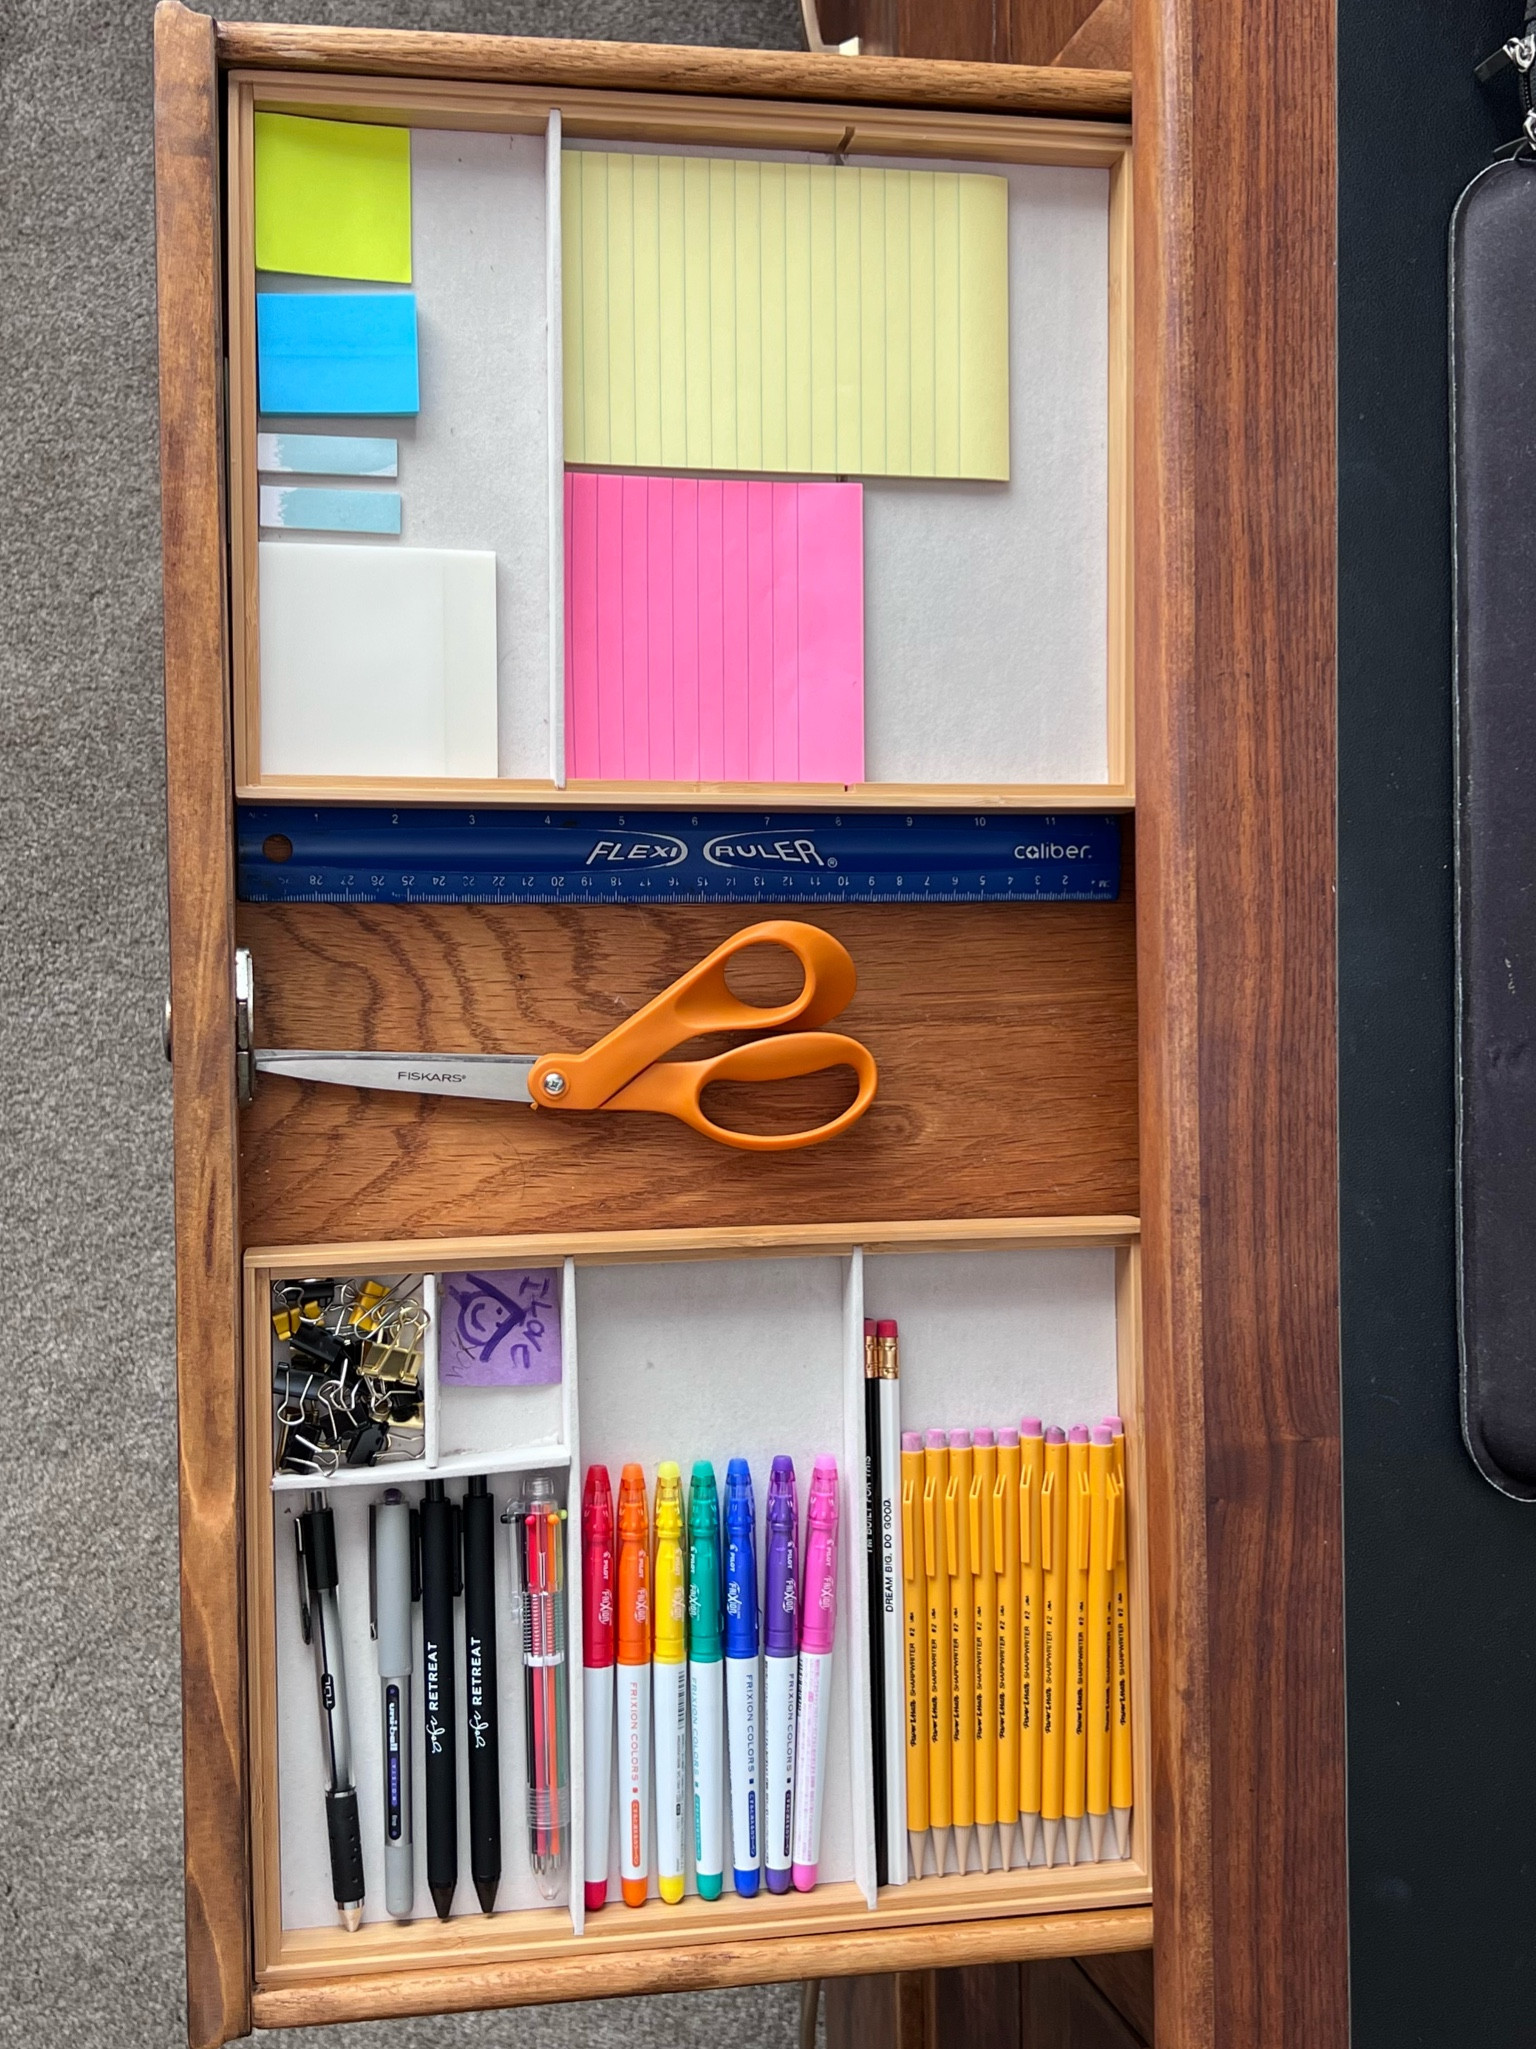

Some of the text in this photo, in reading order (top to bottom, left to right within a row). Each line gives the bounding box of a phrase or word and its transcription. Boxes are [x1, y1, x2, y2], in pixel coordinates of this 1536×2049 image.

[391, 813, 399, 825] 2
[468, 814, 476, 826] 3
[544, 815, 552, 826] 4
[618, 815, 626, 827] 5
[691, 816, 699, 827] 6
[763, 816, 771, 827] 7
[835, 816, 843, 828] 8
[906, 816, 914, 827] 9
[973, 816, 987, 828] 10
[1045, 816, 1057, 827] 11
[586, 841, 680, 865] FLEXI
[309, 874, 324, 887] 28
[370, 874, 385, 888] 26
[401, 874, 416, 888] 25
[432, 875, 447, 888] 24
[491, 875, 506, 888] 22
[521, 875, 535, 888] 21
[550, 875, 565, 888] 20
[580, 875, 593, 888] 19
[609, 875, 623, 888] 18
[668, 876, 681, 888] 16
[696, 875, 710, 887] 15
[726, 875, 738, 887] 14
[753, 875, 766, 887] 13
[782, 875, 794, 888] 12
[809, 875, 822, 887] 11
[837, 875, 850, 888] 10
[868, 875, 876, 887] 9
[896, 875, 903, 887] 8
[923, 875, 931, 887] 7
[951, 875, 959, 887] 6
[979, 875, 987, 887] 5
[1007, 875, 1015, 887] 4
[1034, 874, 1041, 886] 3
[1061, 874, 1069, 886] 2
[884, 1534, 892, 1549] DO
[884, 1576, 894, 1613] DREAM
[427, 1641, 439, 1711] RETREAT
[470, 1636, 482, 1706] RETREAT
[786, 1673, 795, 1720] FRIXION
[745, 1674, 755, 1773] FRIXION COLORS
[629, 1682, 639, 1781] FRIXION COLORS
